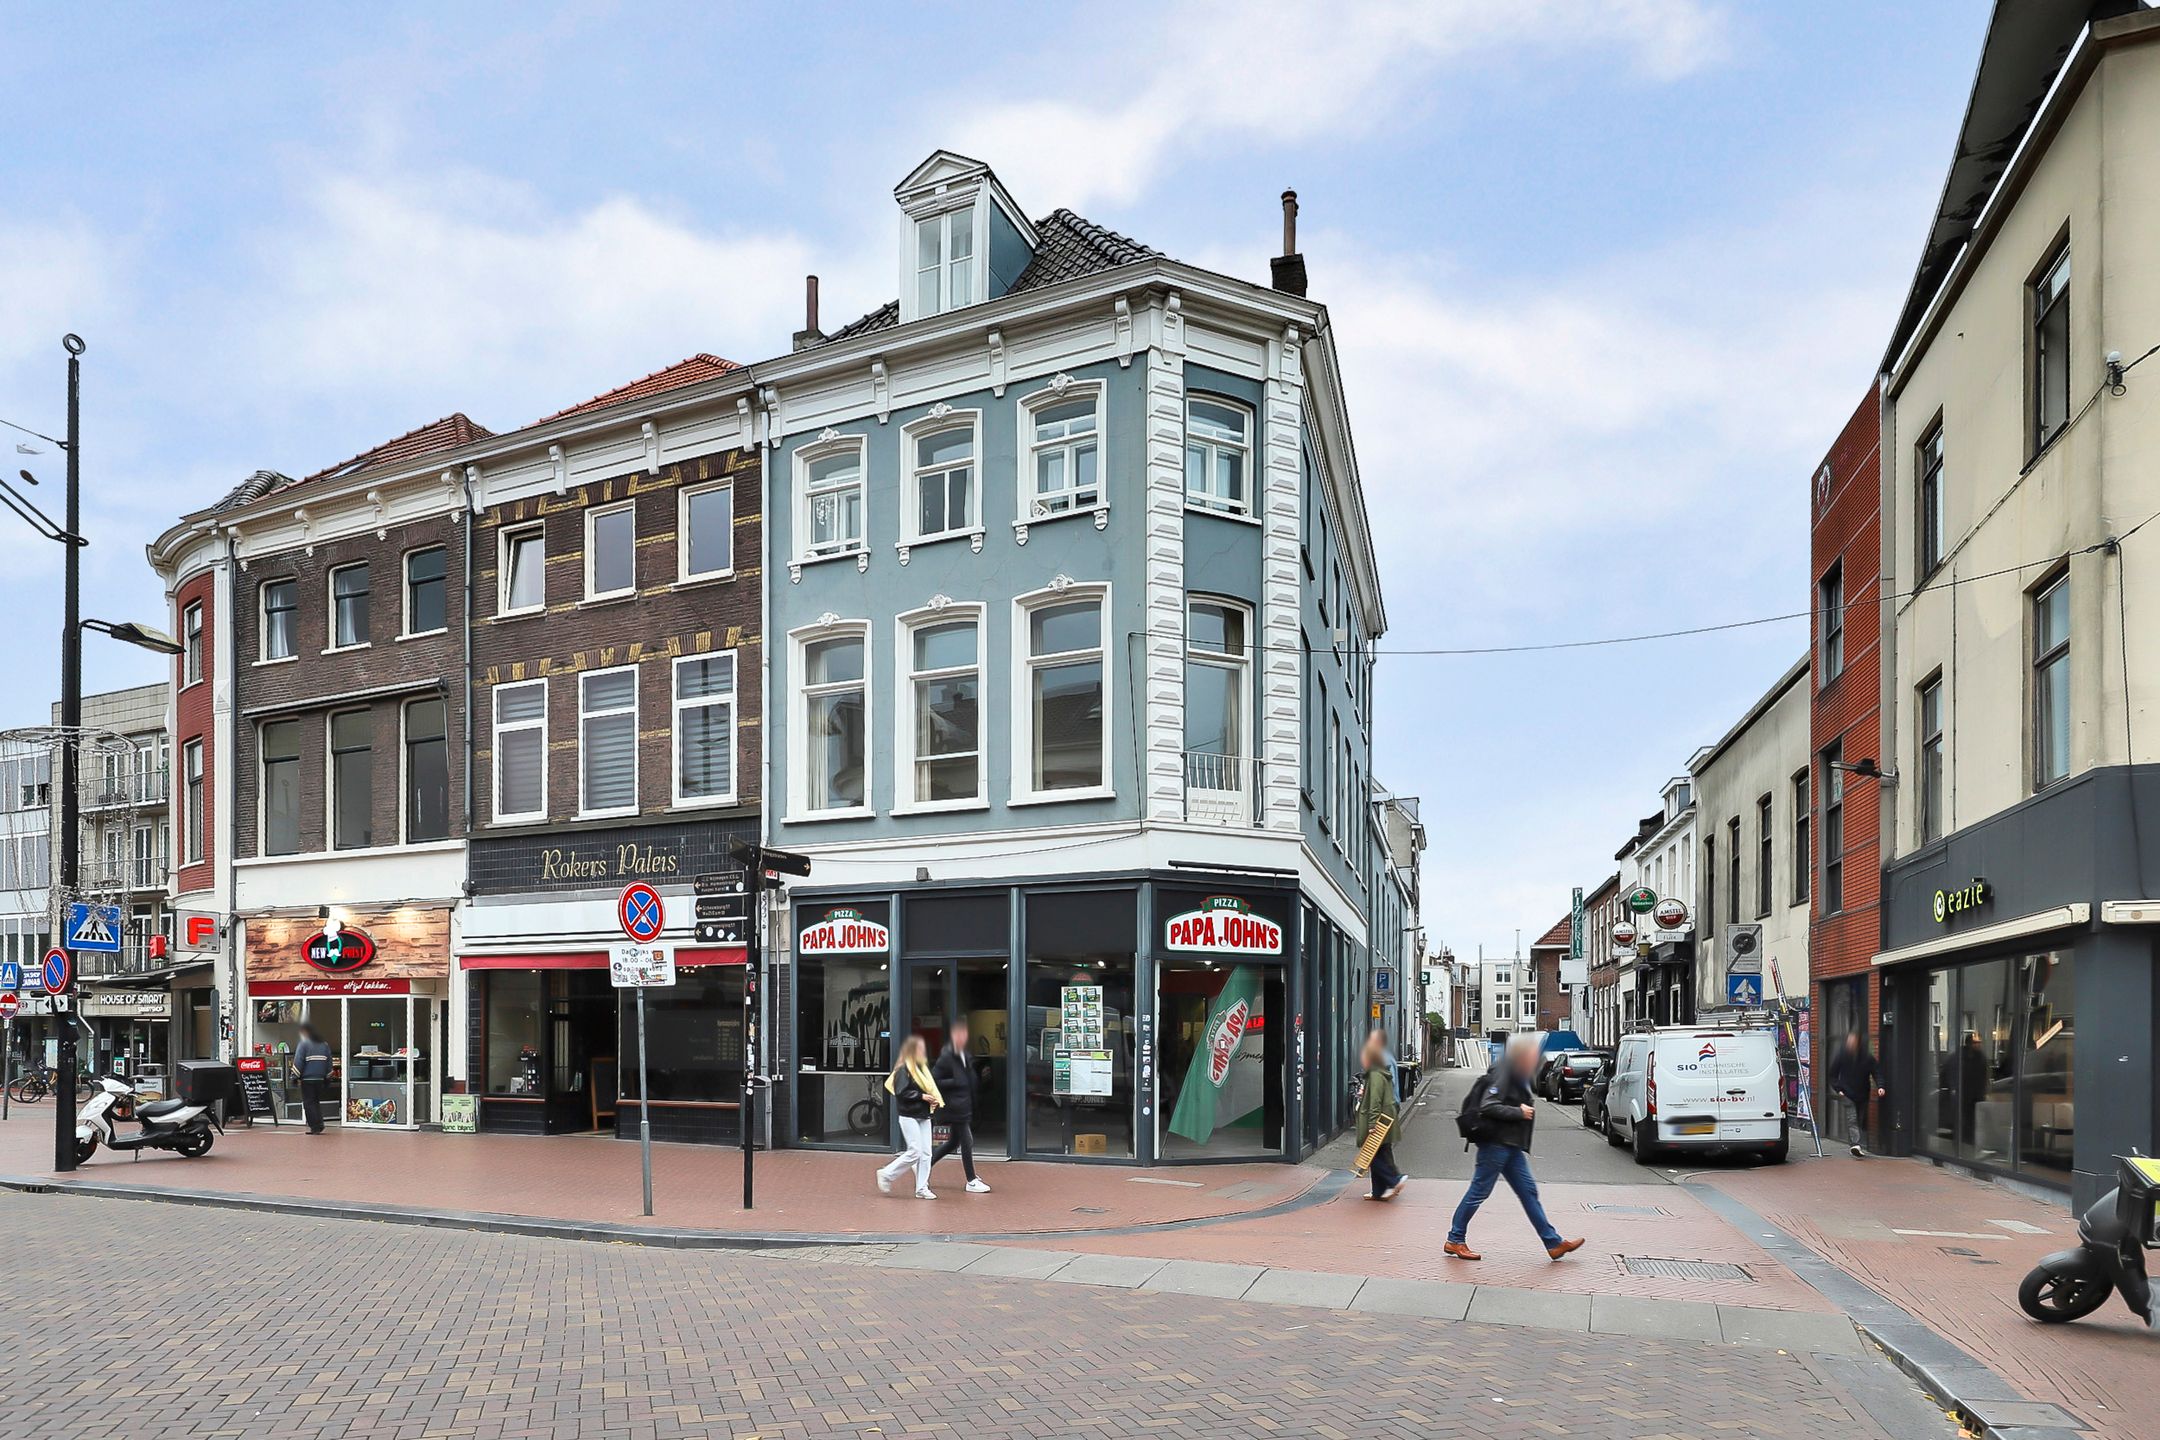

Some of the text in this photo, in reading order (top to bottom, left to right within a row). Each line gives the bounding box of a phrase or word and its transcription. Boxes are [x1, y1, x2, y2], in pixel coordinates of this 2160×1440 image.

[541, 843, 677, 879] Rokers Paleis
[1214, 898, 1238, 908] PIZZA
[1948, 877, 1983, 913] eazie
[834, 910, 853, 918] PIZZA
[1573, 888, 1582, 958] PIZZERIA
[187, 916, 215, 945] F
[803, 925, 886, 949] PAPA JOHN'S
[1170, 917, 1279, 949] PAPA JOHN'S
[311, 947, 327, 959] NEW
[100, 993, 164, 1004] HOUSE OF SMART
[1677, 1063, 1698, 1071] SIO
[1683, 1095, 1756, 1103] www.sio-bv.nl
